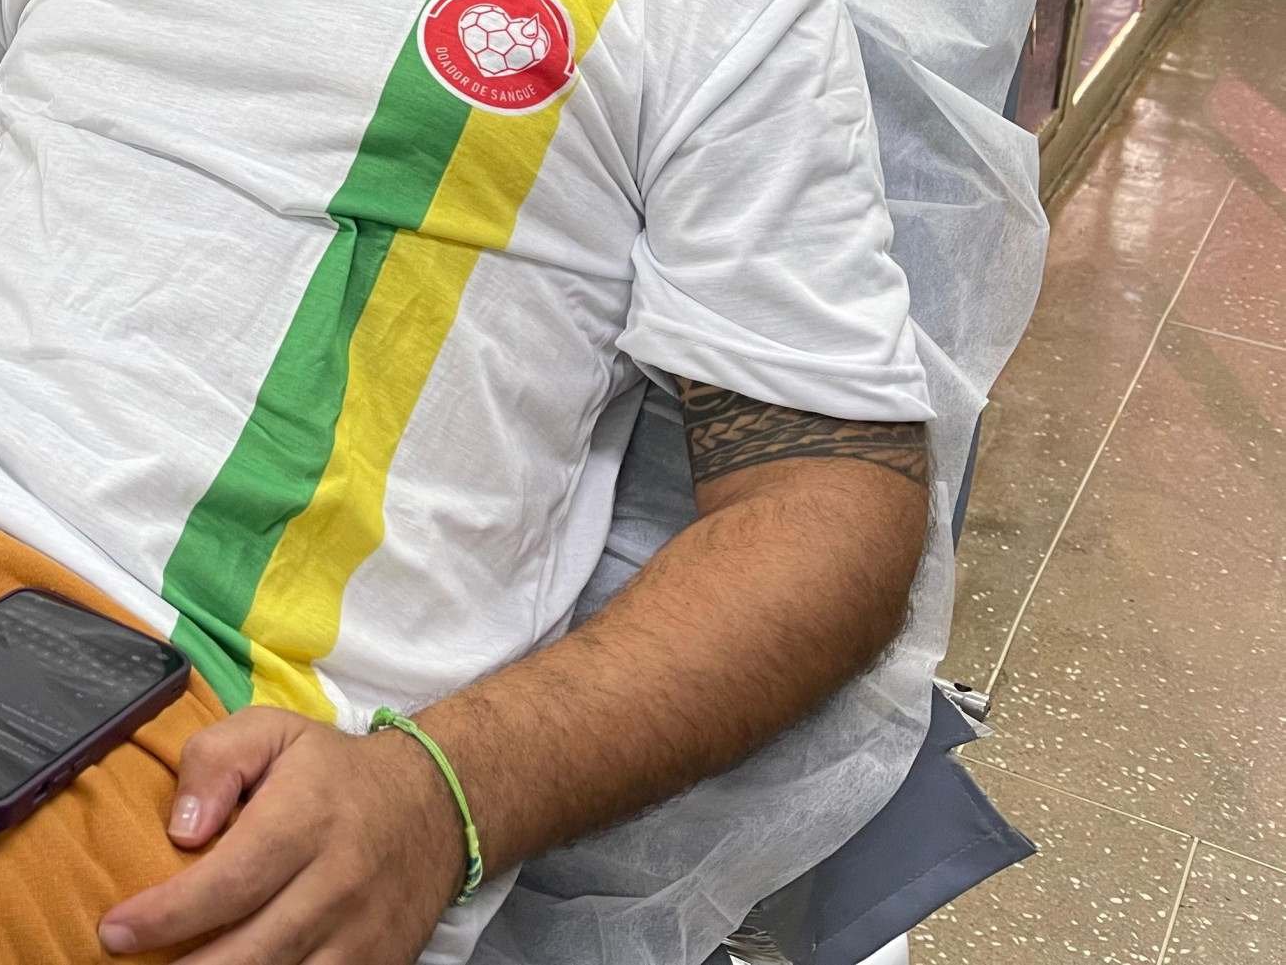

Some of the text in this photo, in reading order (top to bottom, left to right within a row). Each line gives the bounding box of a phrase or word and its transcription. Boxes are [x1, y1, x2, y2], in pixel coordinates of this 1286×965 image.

[436, 46, 537, 102] DOADOR DE SANGUE
